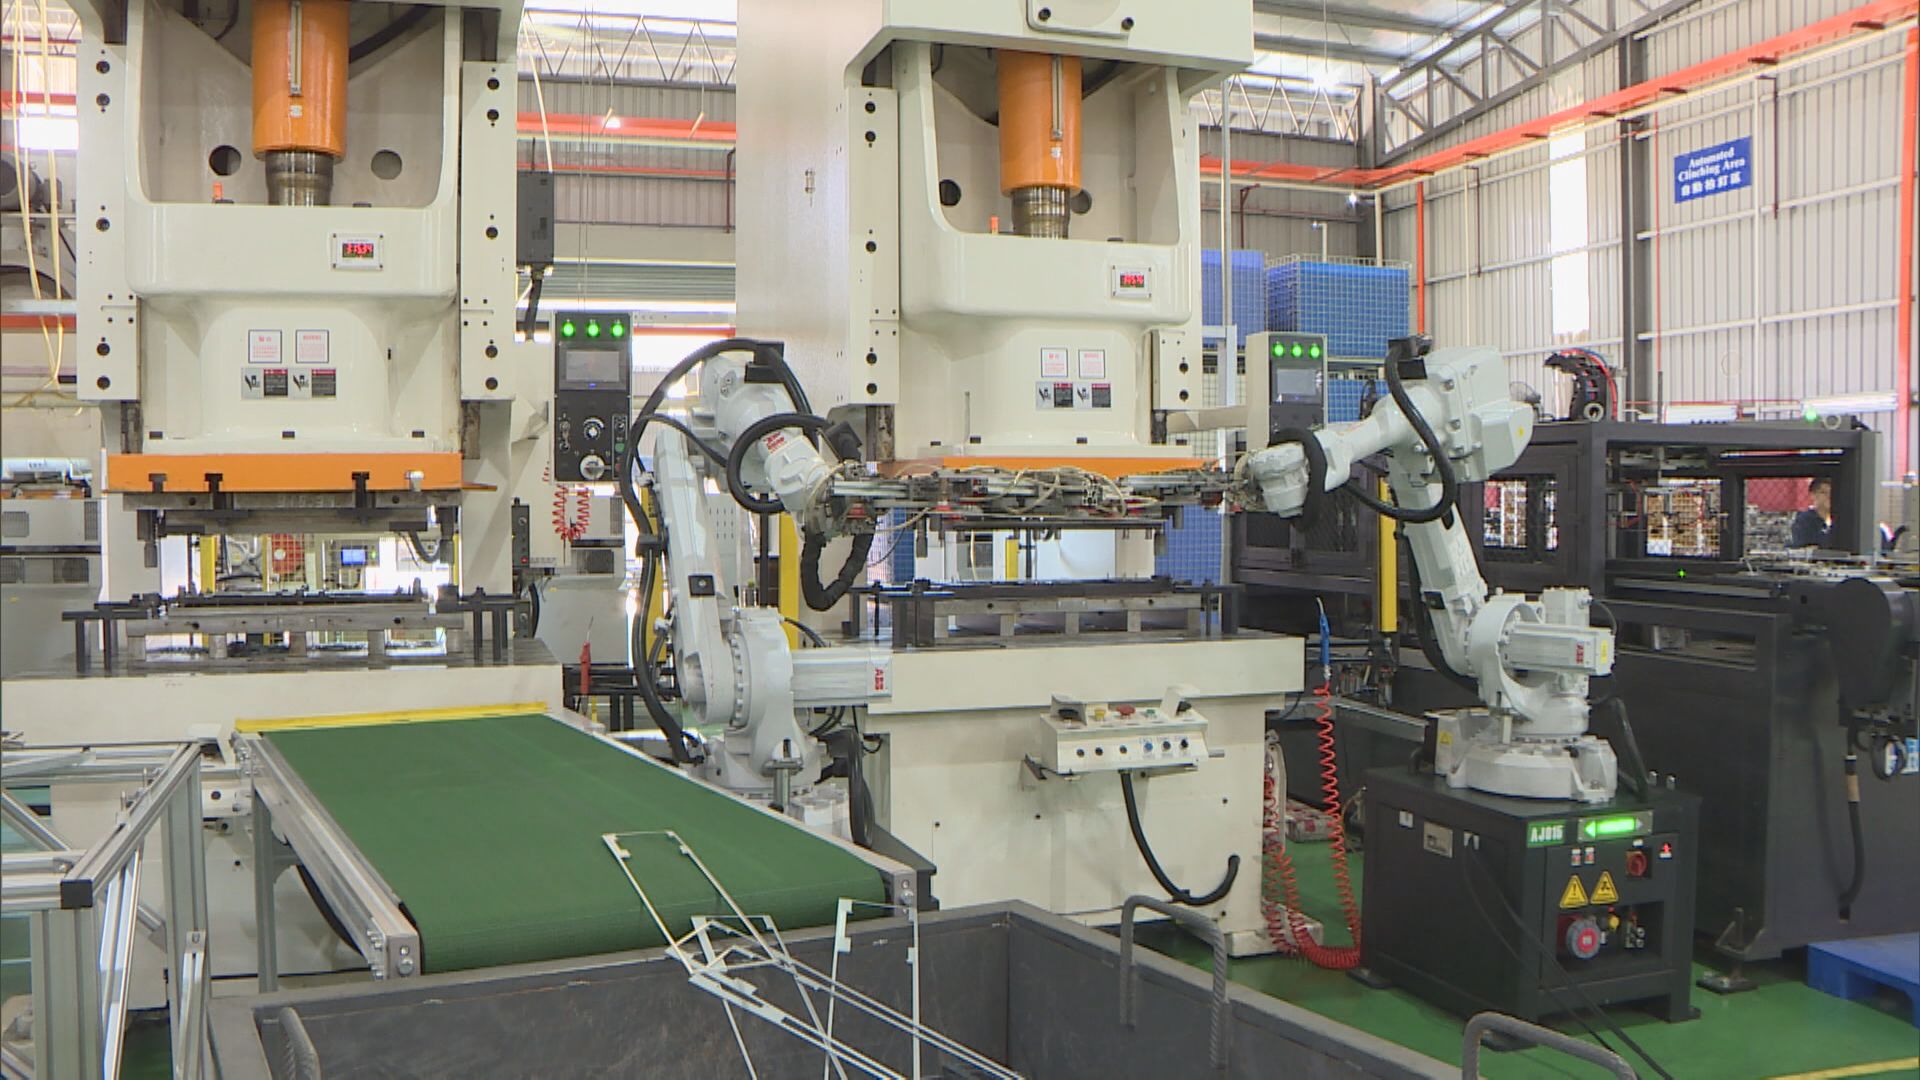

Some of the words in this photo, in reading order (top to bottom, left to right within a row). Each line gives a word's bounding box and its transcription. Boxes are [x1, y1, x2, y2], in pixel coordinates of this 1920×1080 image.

[1688, 146, 1735, 169] Automated
[1678, 164, 1721, 183] Clinching
[1722, 158, 1746, 171] Area
[875, 668, 884, 690] ABB
